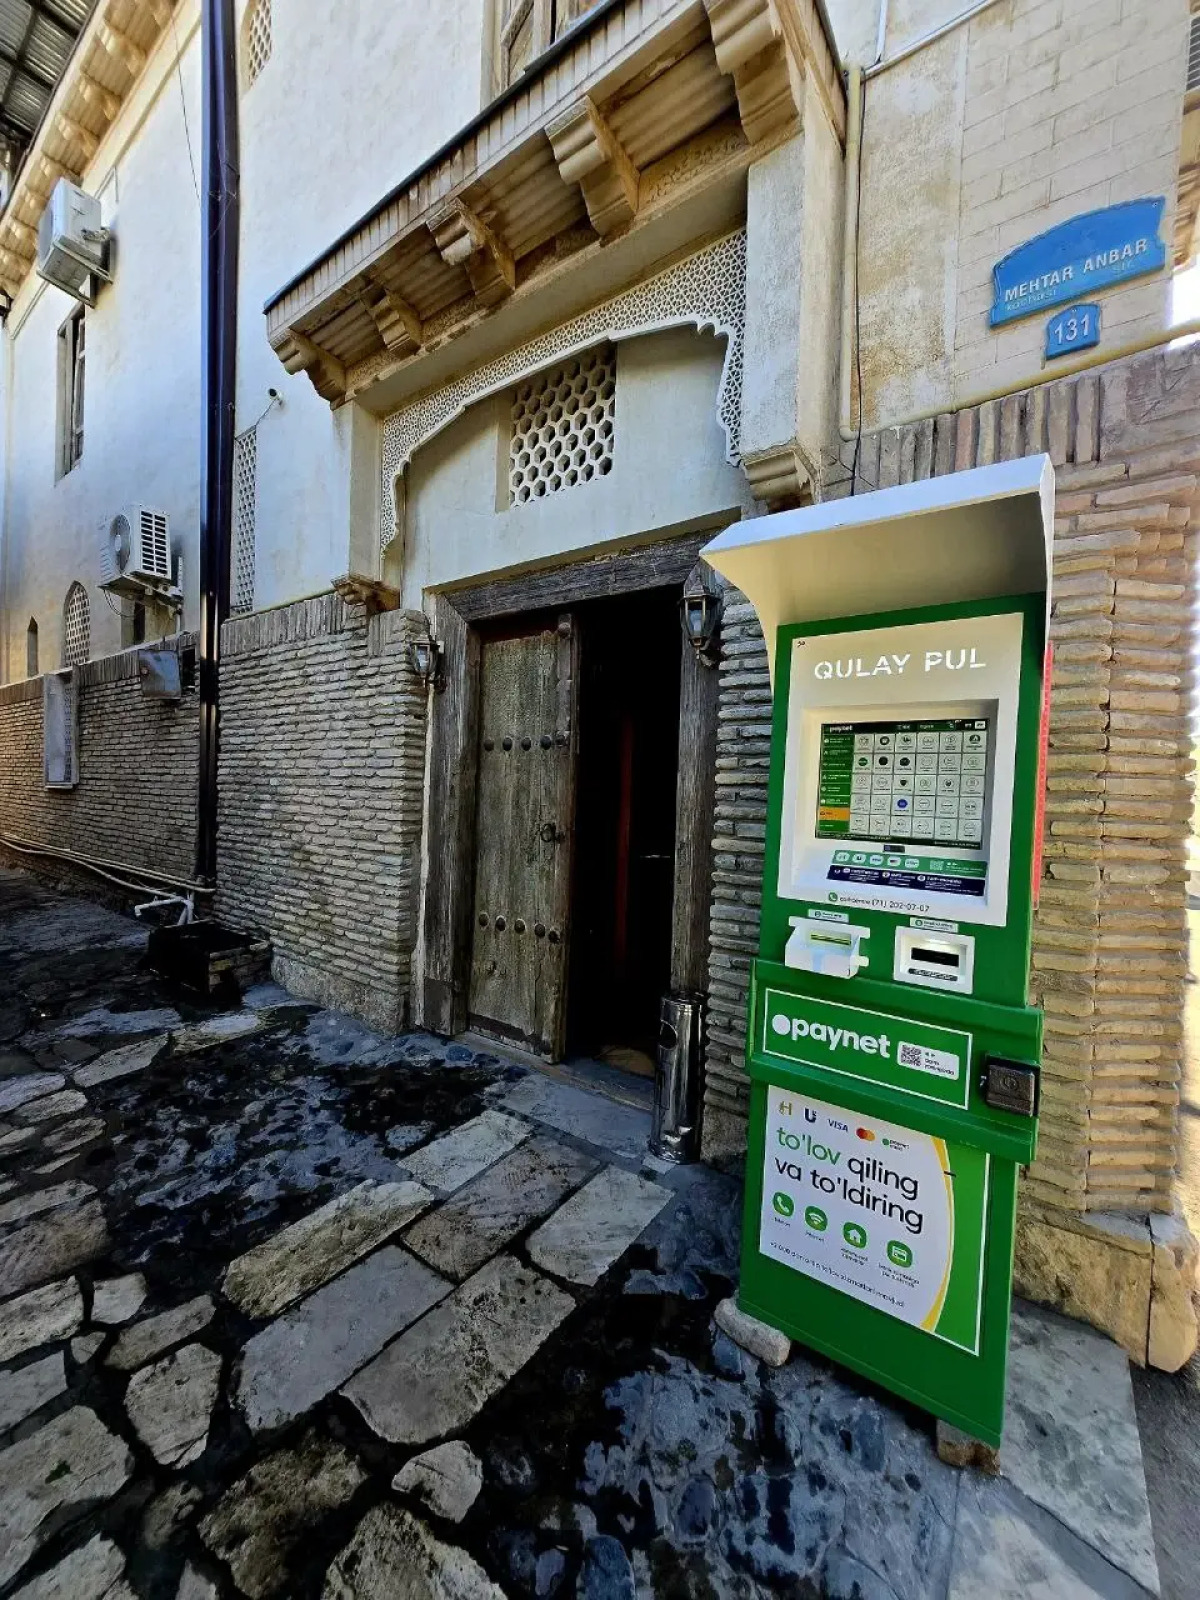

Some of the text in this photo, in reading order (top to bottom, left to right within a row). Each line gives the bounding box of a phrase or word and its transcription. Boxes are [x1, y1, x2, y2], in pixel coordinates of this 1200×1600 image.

[1004, 265, 1074, 301] MEHTAR
[1083, 238, 1147, 272] ANBAR
[1054, 313, 1090, 345] 131
[814, 648, 987, 680] QULAY PUL
[791, 1018, 891, 1058] paynet
[828, 1118, 849, 1132] VISA
[776, 1127, 919, 1201] to'lov qiling
[774, 1157, 924, 1234] va to'ldiring
